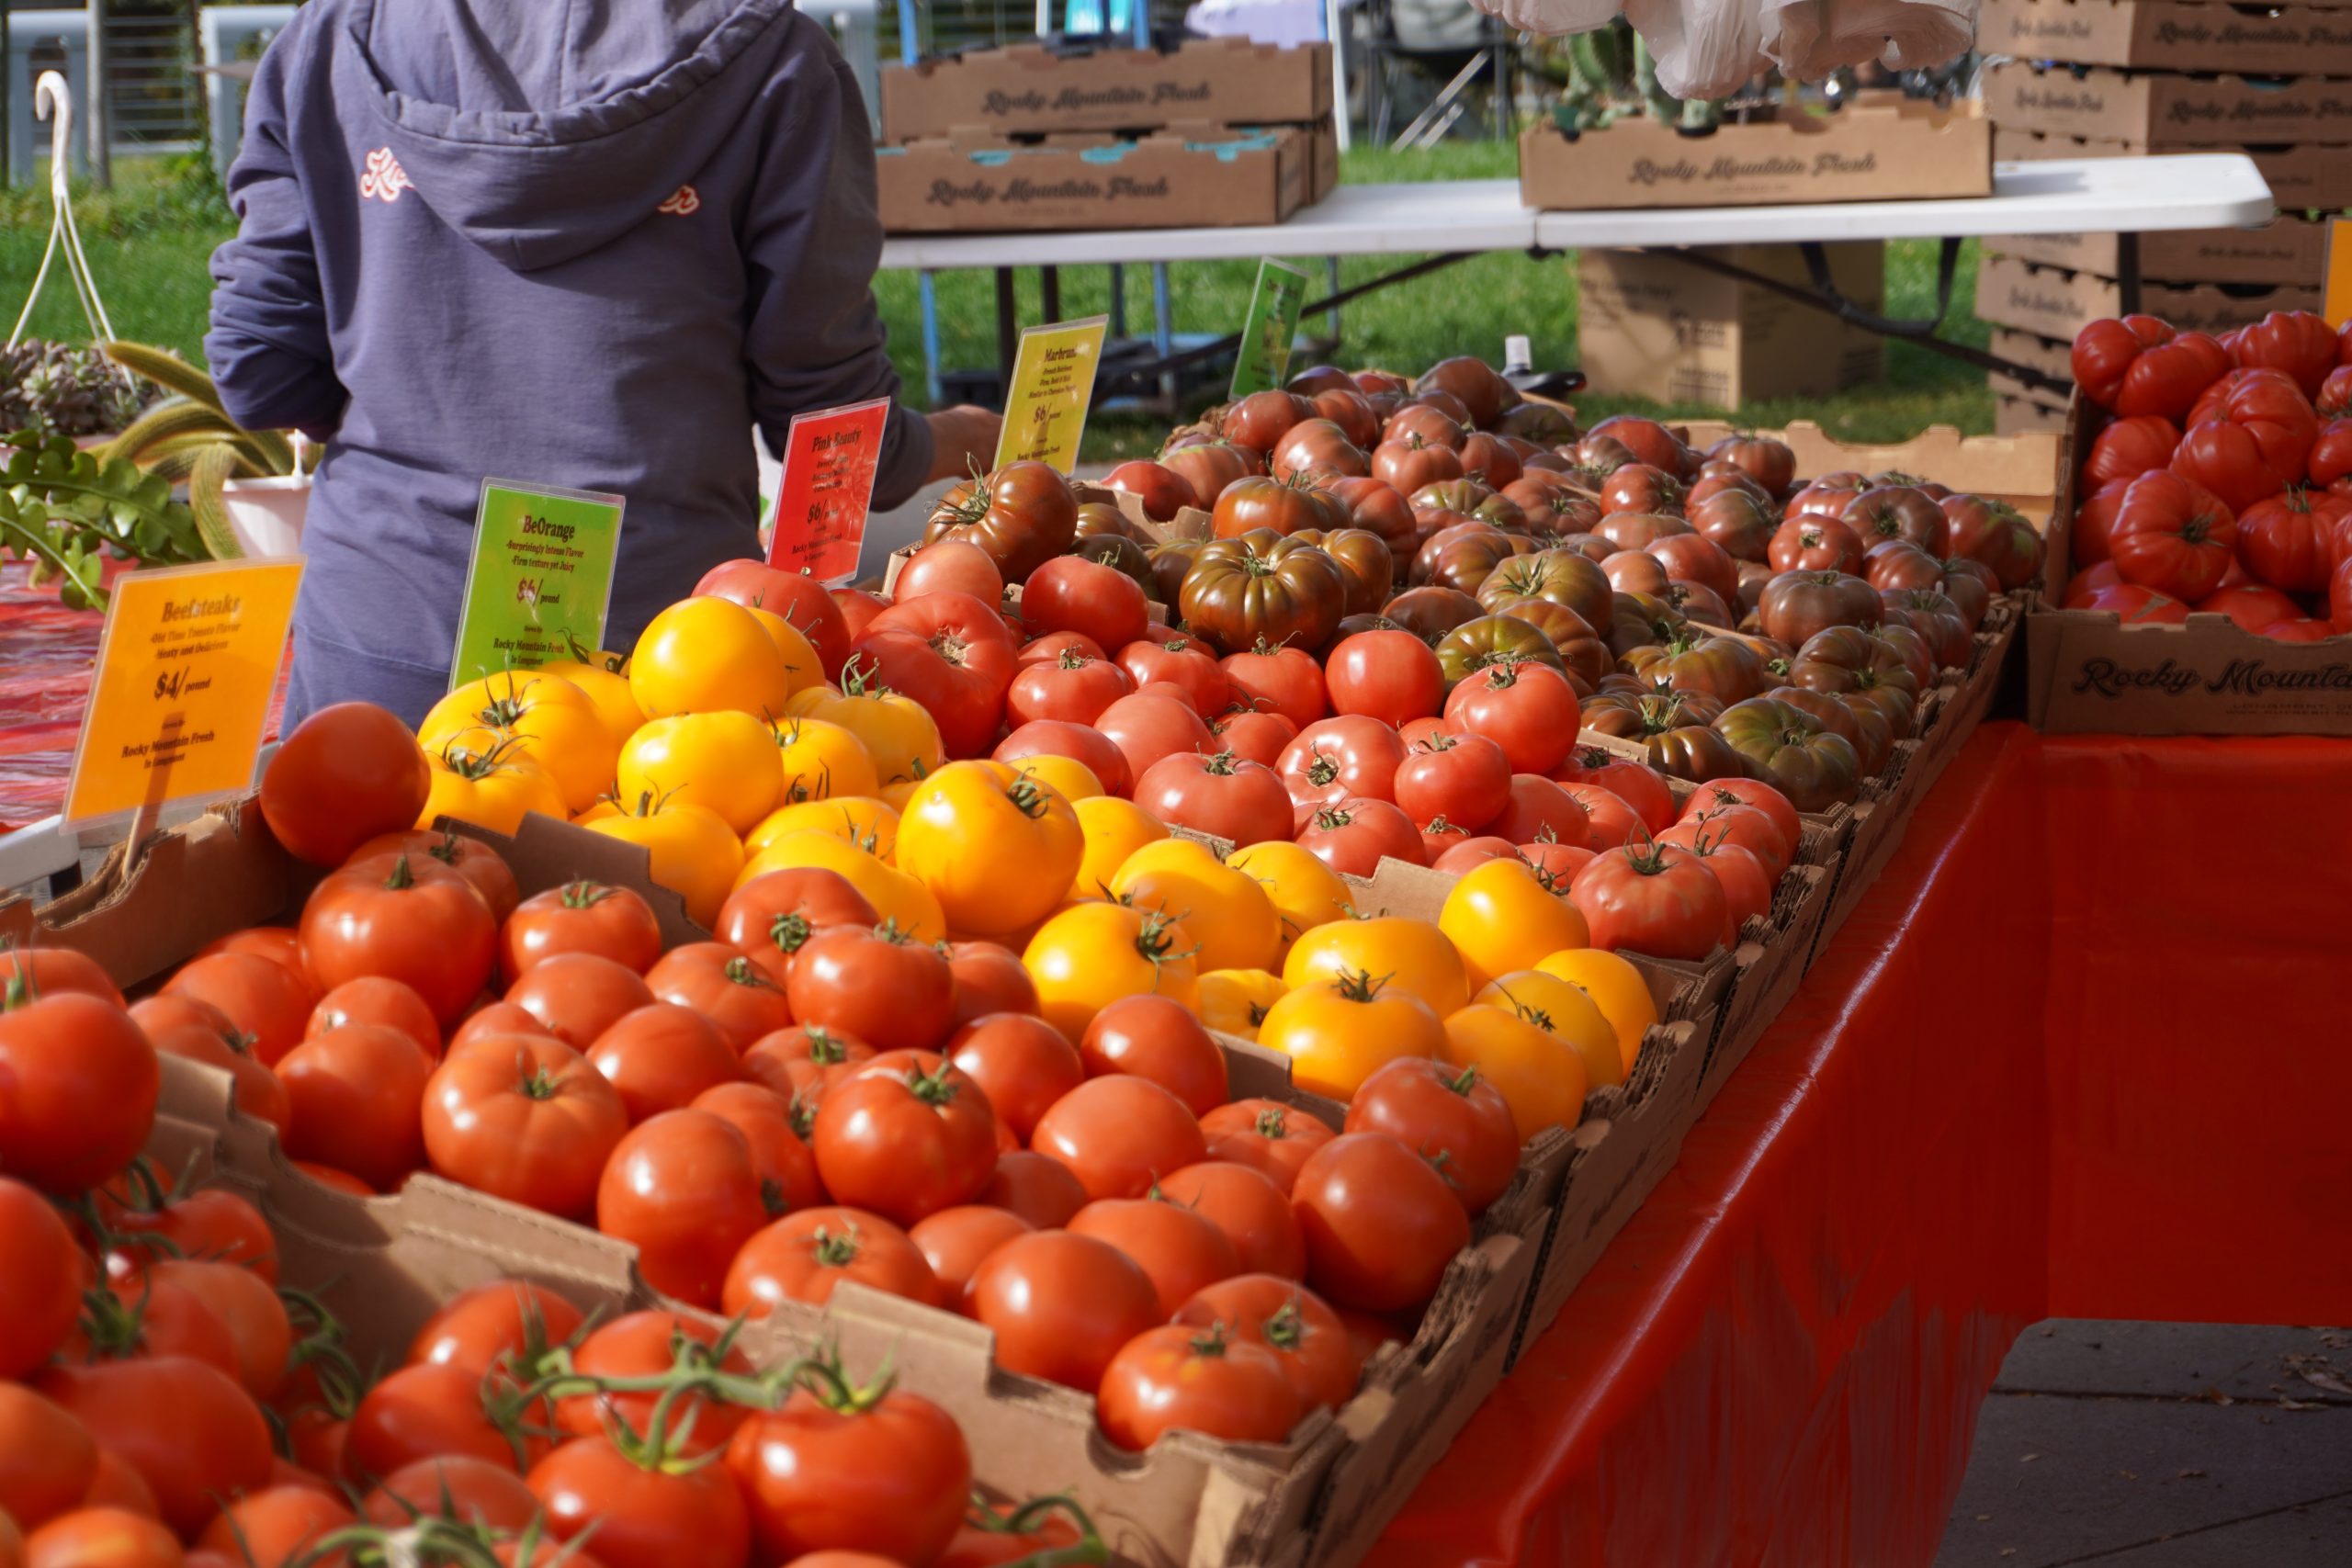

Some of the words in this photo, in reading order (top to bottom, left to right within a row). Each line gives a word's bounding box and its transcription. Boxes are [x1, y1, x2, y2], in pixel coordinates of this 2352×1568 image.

[812, 435, 832, 453] Pink
[523, 515, 575, 543] BeOrange
[546, 545, 565, 556] Intense
[566, 547, 584, 558] Flavor
[560, 561, 575, 573] Juicy
[493, 638, 514, 650] Rocky
[2072, 657, 2201, 701] Rocky
[2208, 659, 2352, 696] Mounta
[122, 745, 150, 758] Rocky
[190, 731, 215, 744] Fresh
